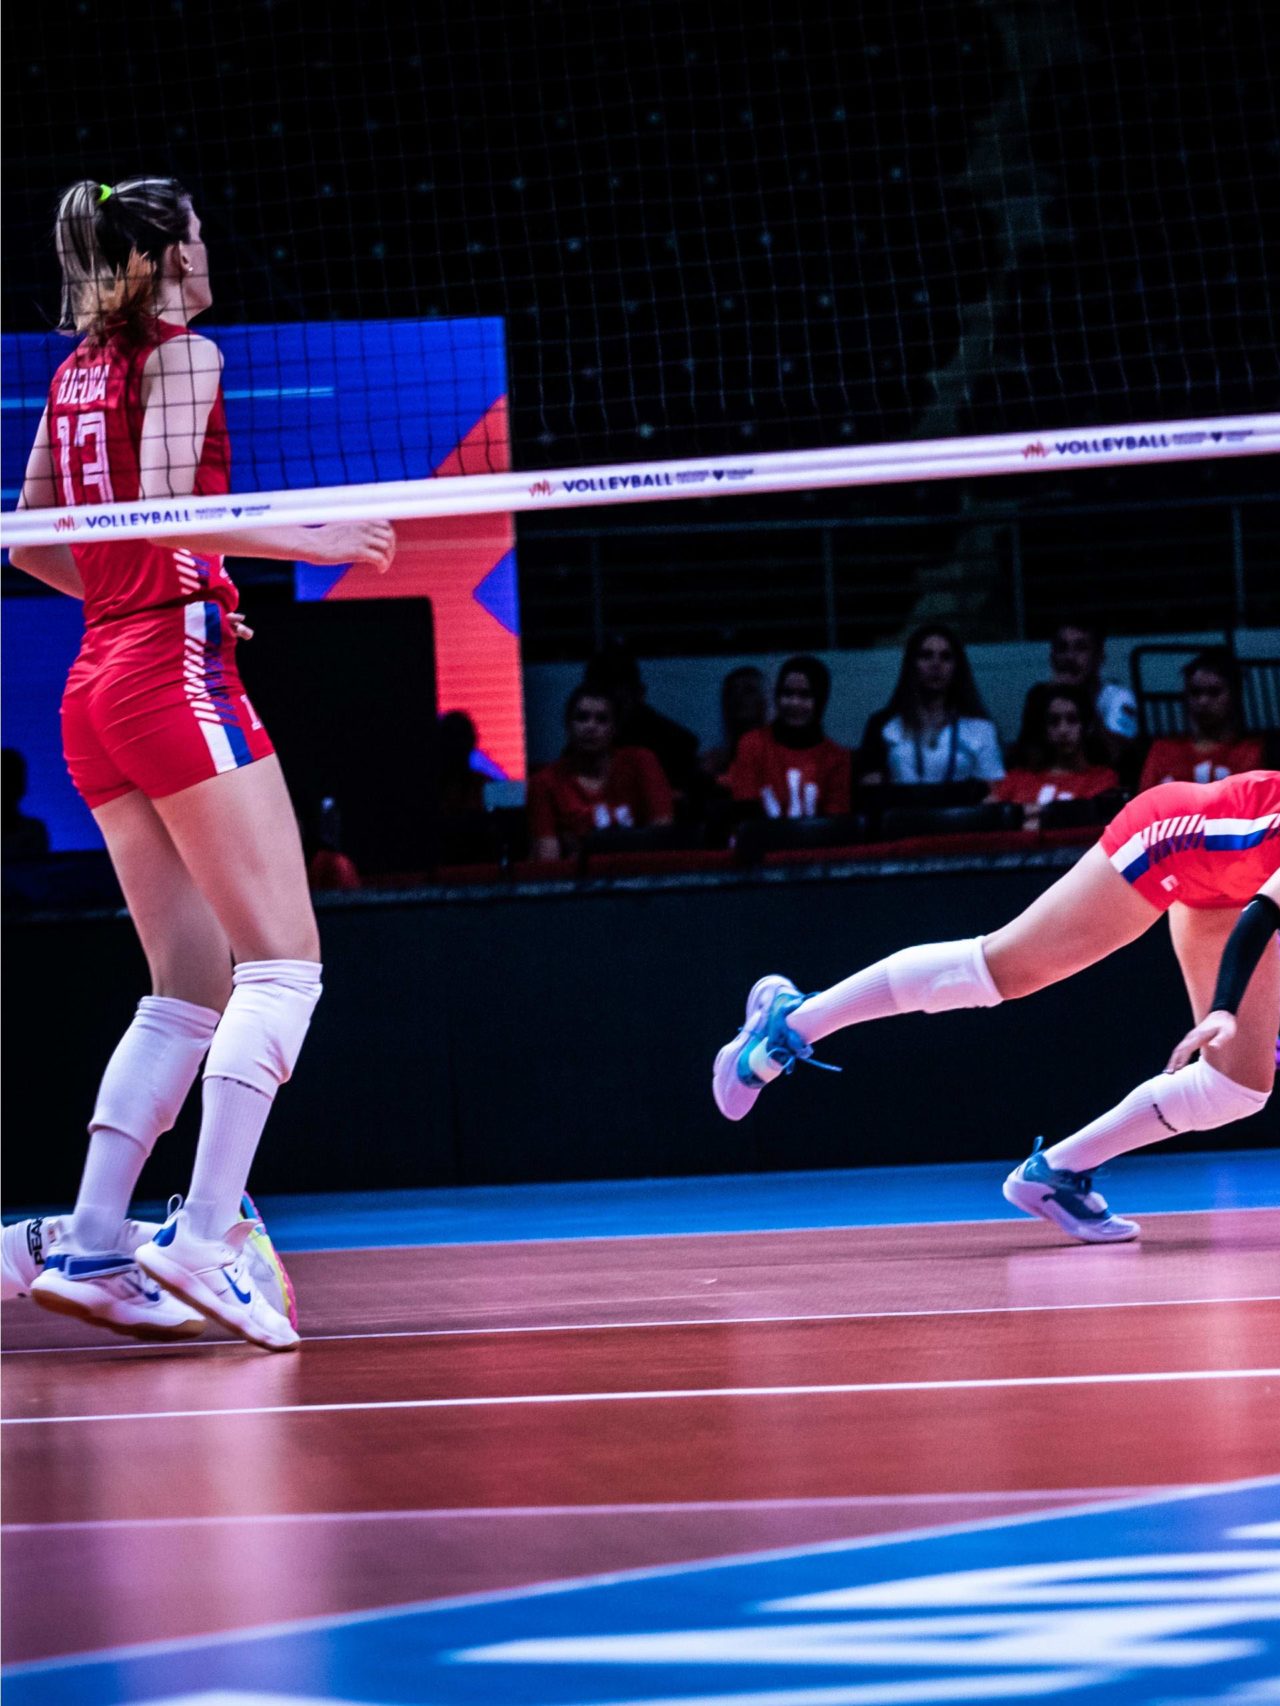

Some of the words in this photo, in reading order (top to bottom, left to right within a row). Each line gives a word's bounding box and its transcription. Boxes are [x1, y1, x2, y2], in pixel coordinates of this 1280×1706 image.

[1055, 434, 1169, 455] VOLLEYBALL
[562, 473, 673, 493] VOLLEYBALL
[85, 509, 192, 529] VOLLEYBALL
